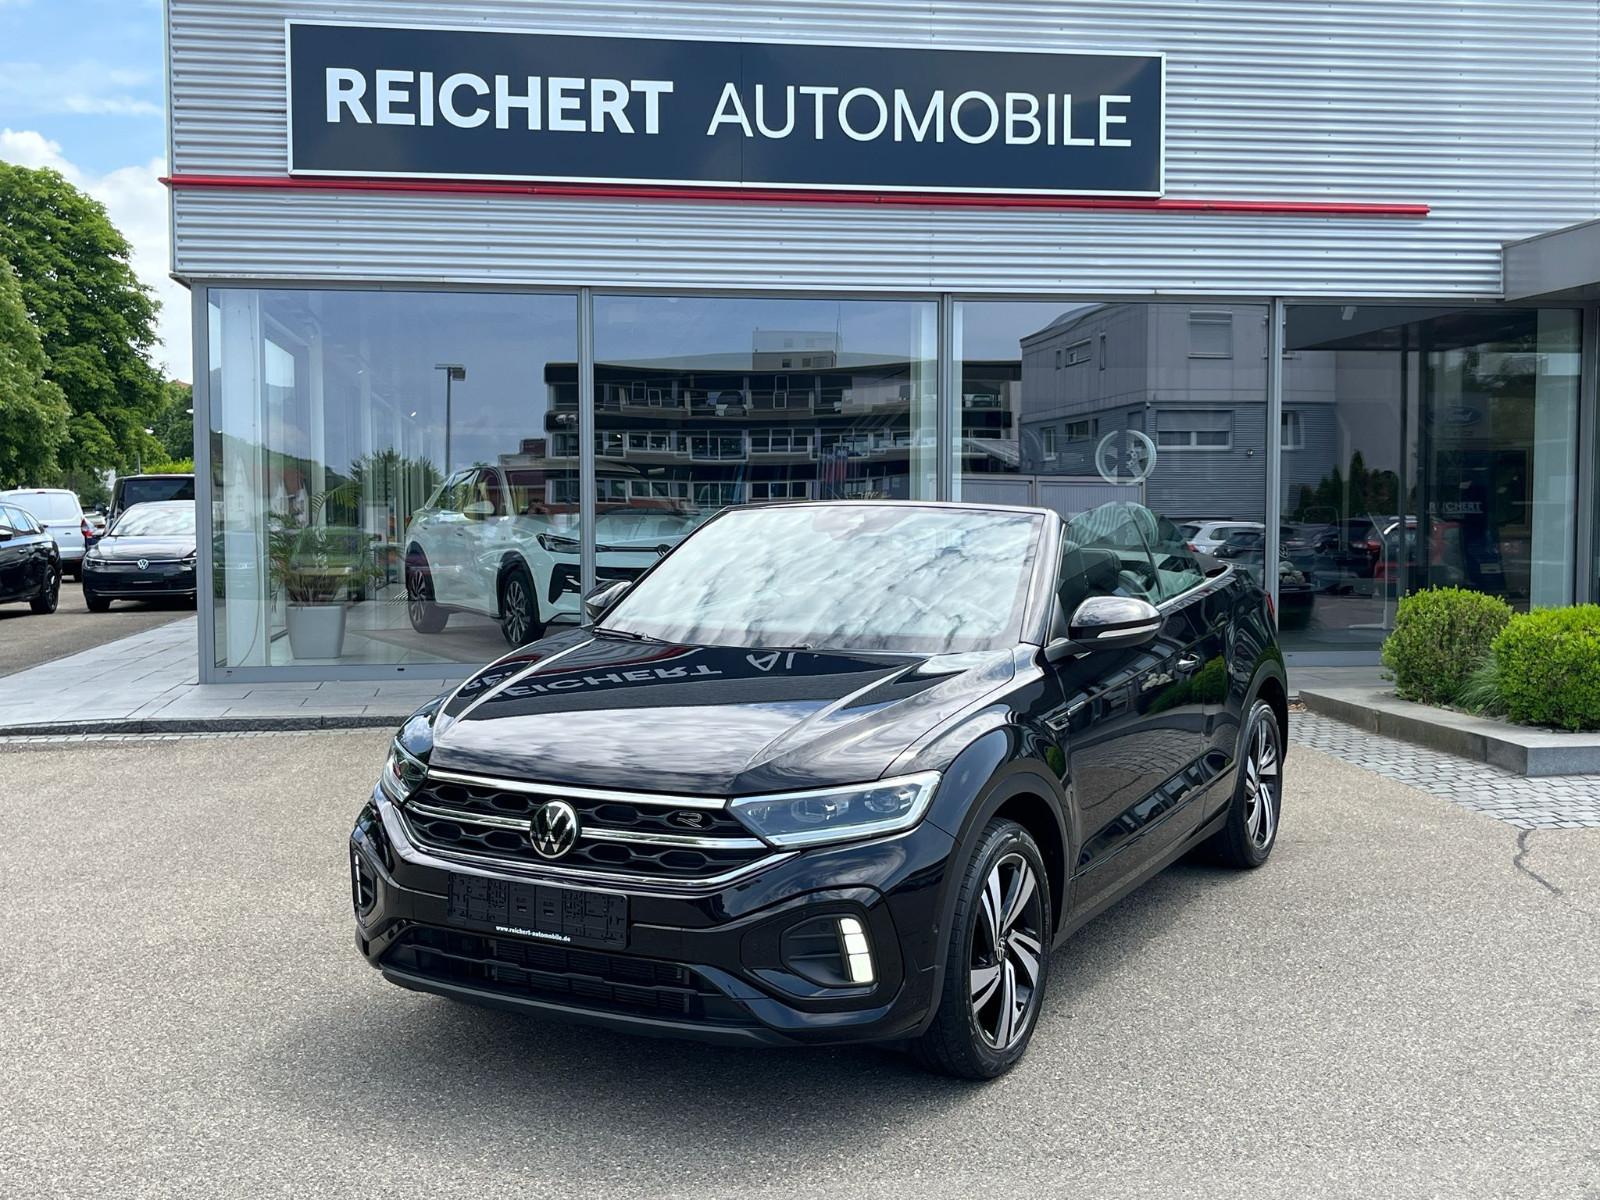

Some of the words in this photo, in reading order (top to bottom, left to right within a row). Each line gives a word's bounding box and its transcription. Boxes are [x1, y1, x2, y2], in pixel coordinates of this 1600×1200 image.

[325, 67, 674, 134] REICHERT
[706, 82, 1133, 147] AUTOMOBILE
[1428, 501, 1484, 513] RICHERT
[530, 800, 578, 858] VW
[495, 925, 571, 943] www.reichert-automobile.de
